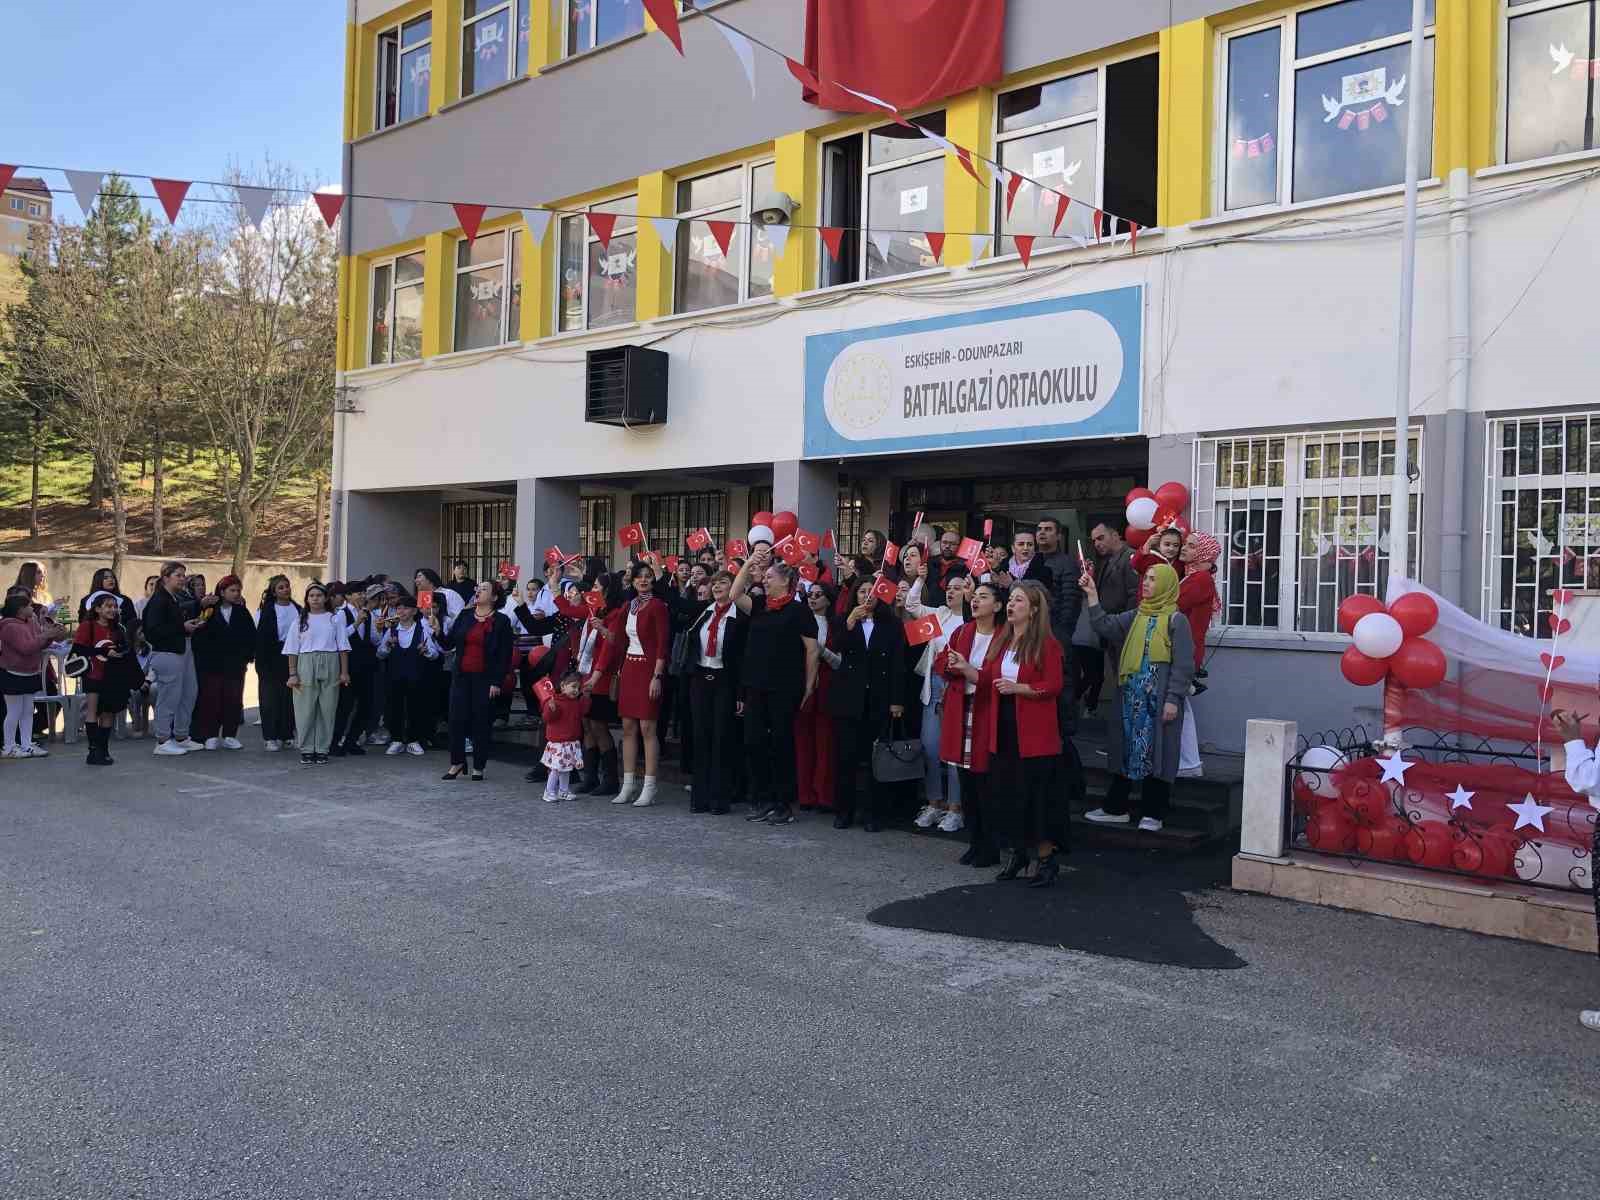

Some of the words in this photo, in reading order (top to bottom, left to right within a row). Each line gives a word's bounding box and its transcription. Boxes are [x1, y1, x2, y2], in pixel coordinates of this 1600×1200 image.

[905, 347, 951, 369] ESKİŞEHİR
[958, 341, 1023, 362] ODUNPAZARI
[904, 369, 993, 419] BATTALGAZİ
[996, 364, 1098, 410] ORTAOKULU
